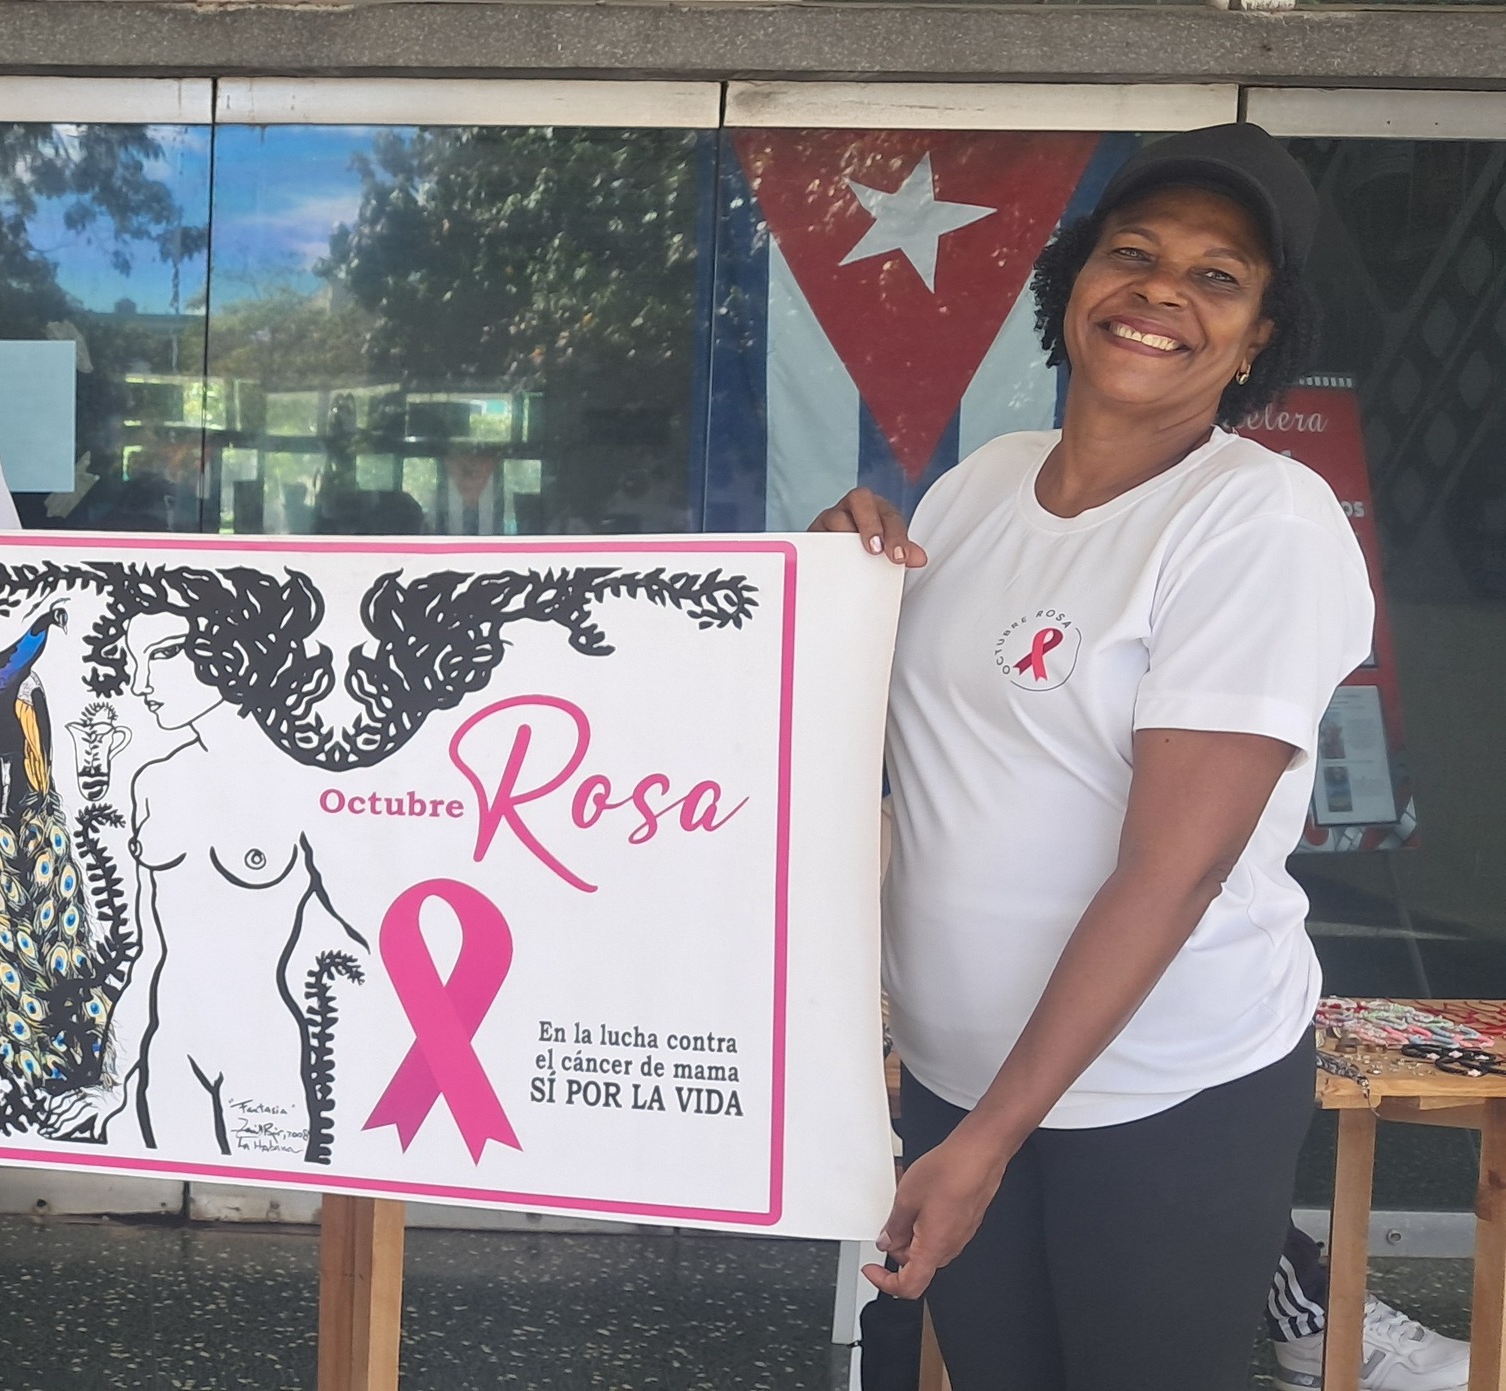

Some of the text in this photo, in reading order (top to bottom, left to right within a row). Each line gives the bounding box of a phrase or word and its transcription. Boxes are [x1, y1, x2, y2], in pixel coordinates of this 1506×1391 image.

[1222, 401, 1329, 433] elera
[994, 609, 1072, 675] OCTUBRE ROSA
[319, 693, 750, 893] Octubre Rosa
[538, 1020, 738, 1054] En la lucha contra
[535, 1047, 740, 1083] el cáncer de mama
[530, 1070, 744, 1117] SÍ POR LA VIDA
